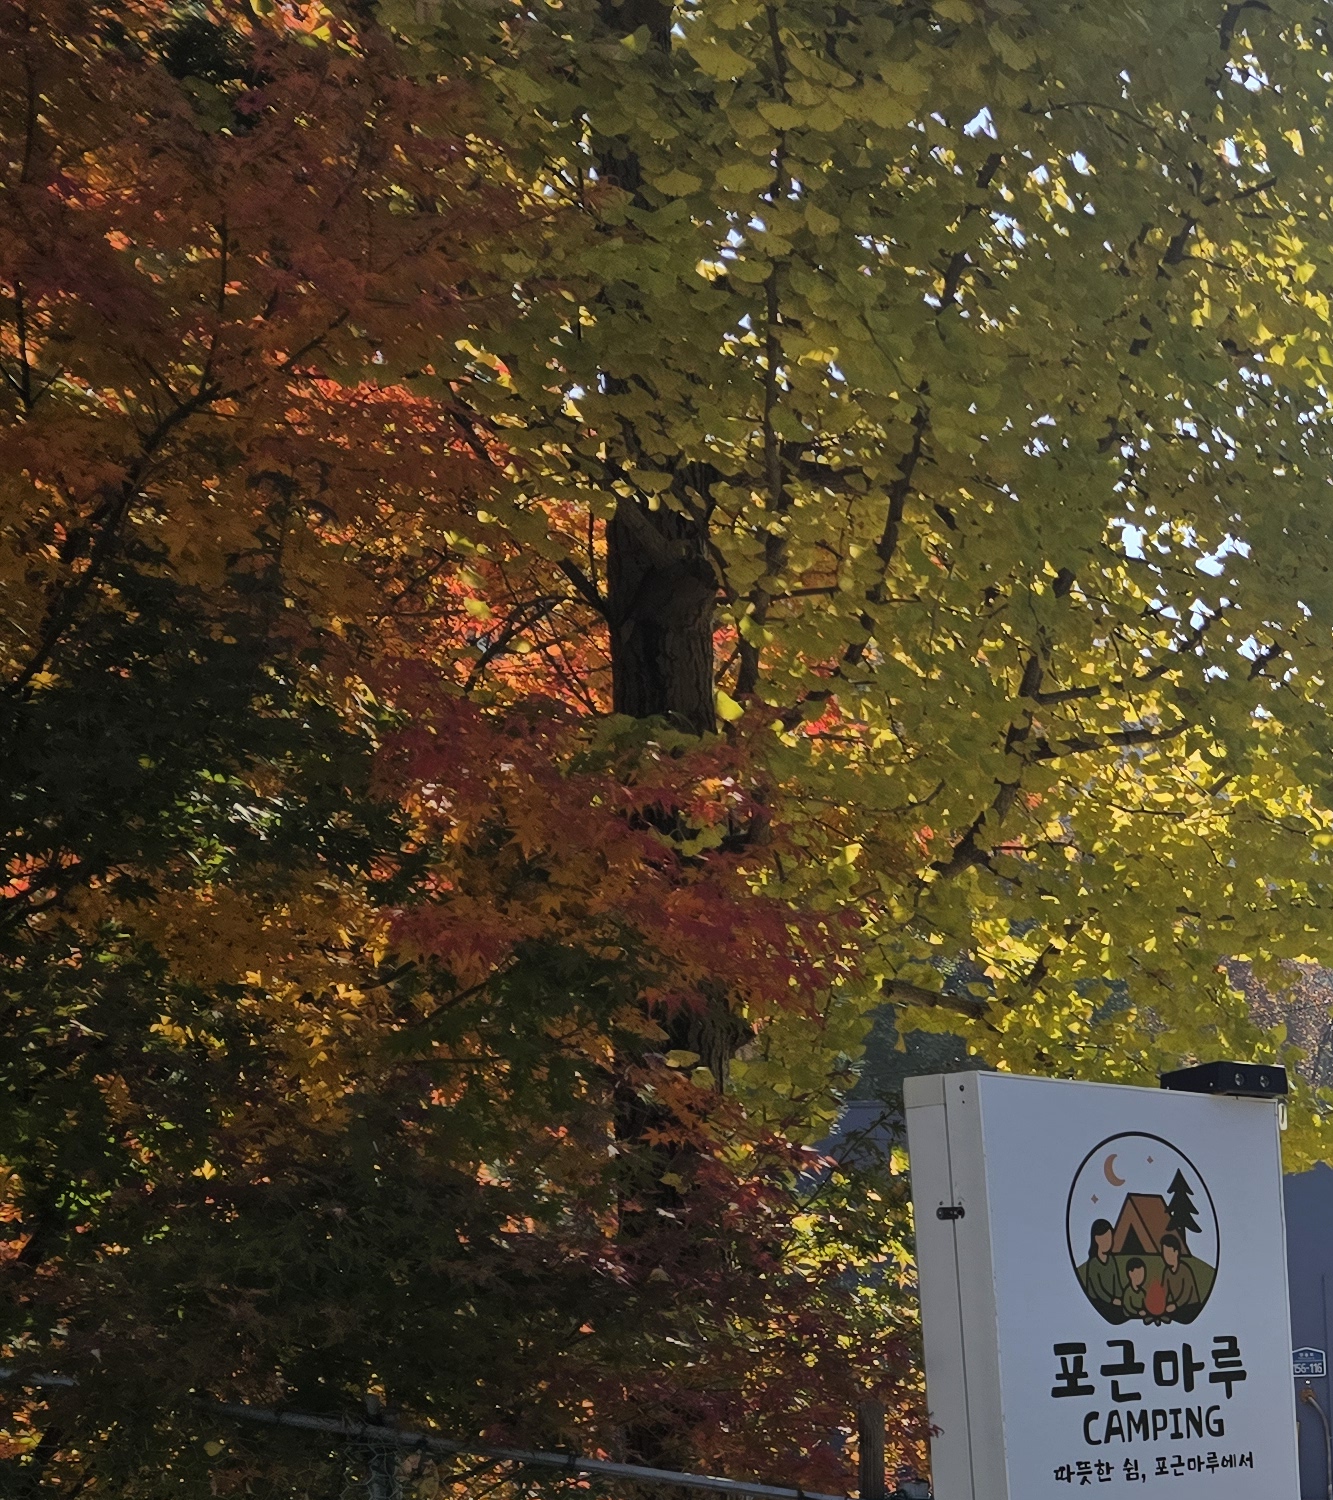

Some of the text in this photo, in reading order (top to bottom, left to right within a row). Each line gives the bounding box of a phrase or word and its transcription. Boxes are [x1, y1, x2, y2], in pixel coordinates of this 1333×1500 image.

[1050, 1335, 1247, 1403] 포근마루
[1083, 1404, 1225, 1446] CAMPING
[1053, 1451, 1254, 1486] 따뜻한 쉼, 포근마루에서
